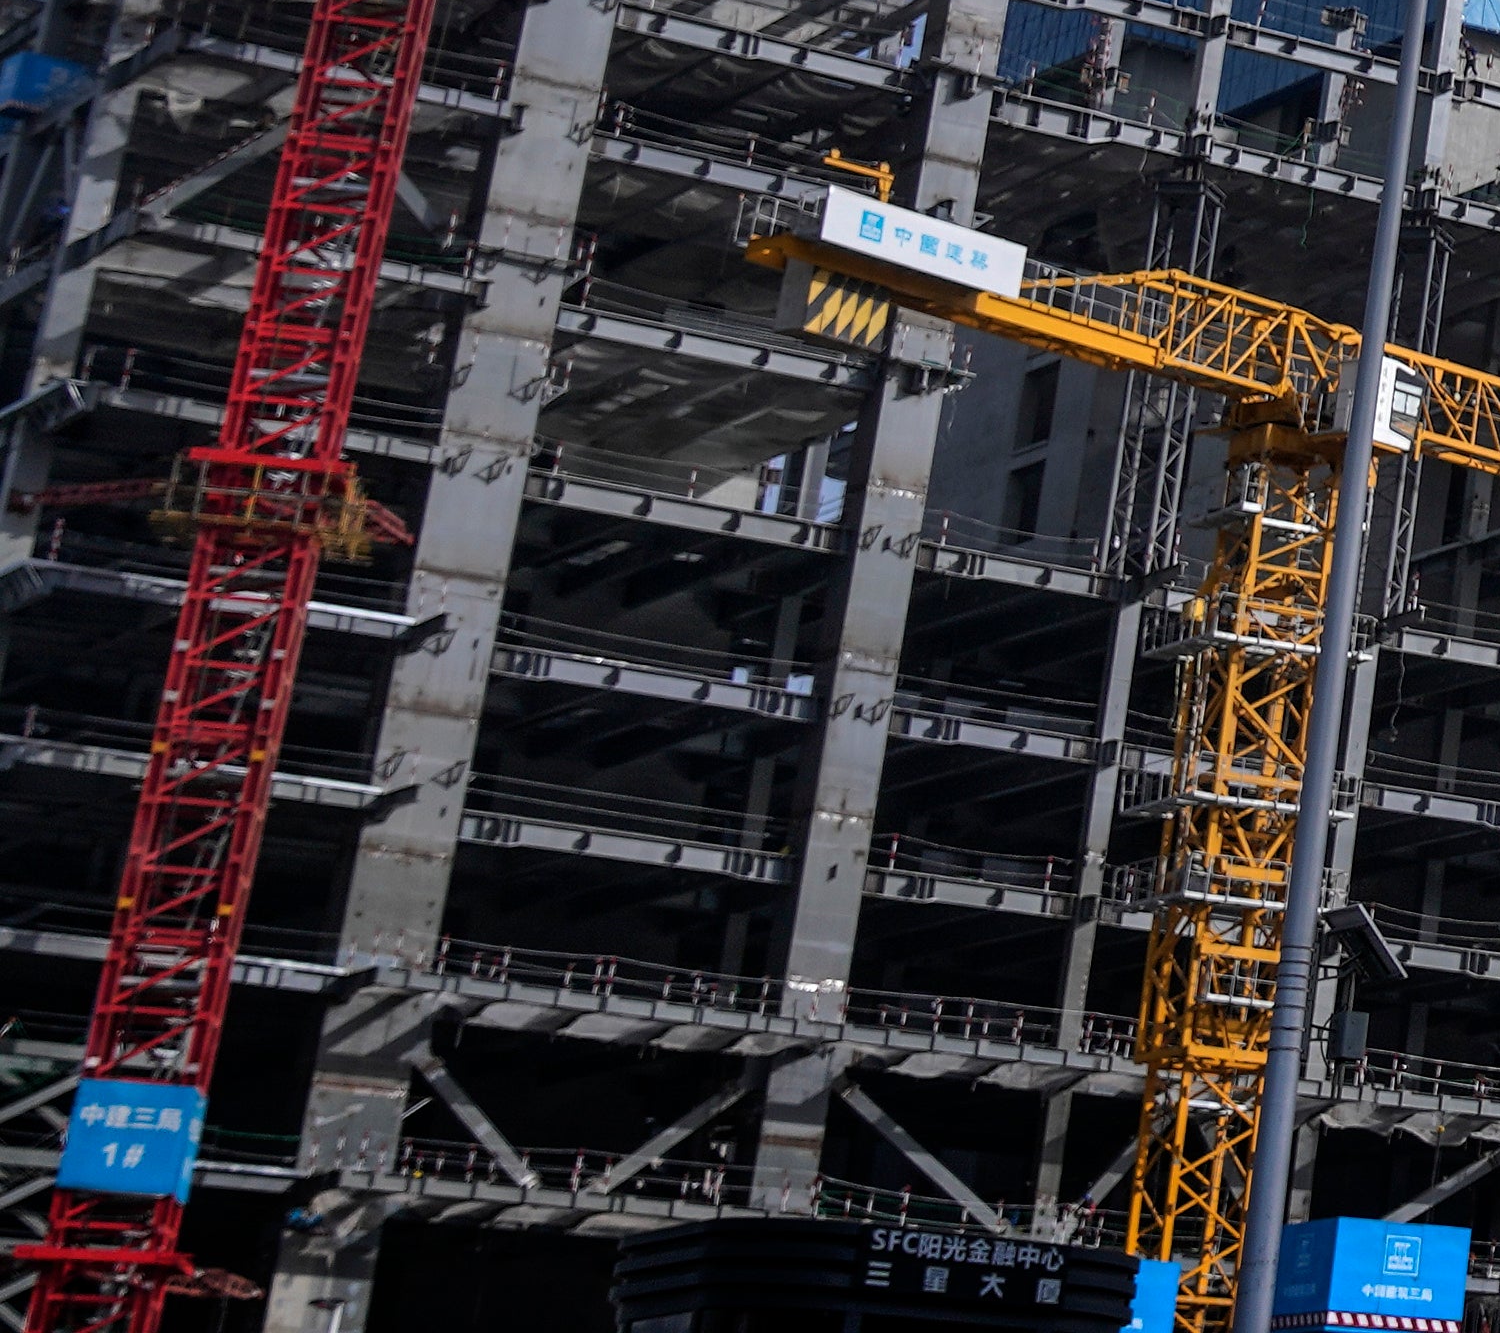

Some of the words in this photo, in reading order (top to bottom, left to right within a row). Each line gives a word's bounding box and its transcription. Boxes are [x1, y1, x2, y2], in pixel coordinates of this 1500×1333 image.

[79, 1102, 183, 1133] 中建三局
[102, 1141, 146, 1169] 1#
[871, 1227, 1065, 1273] SFC阳光金融中心
